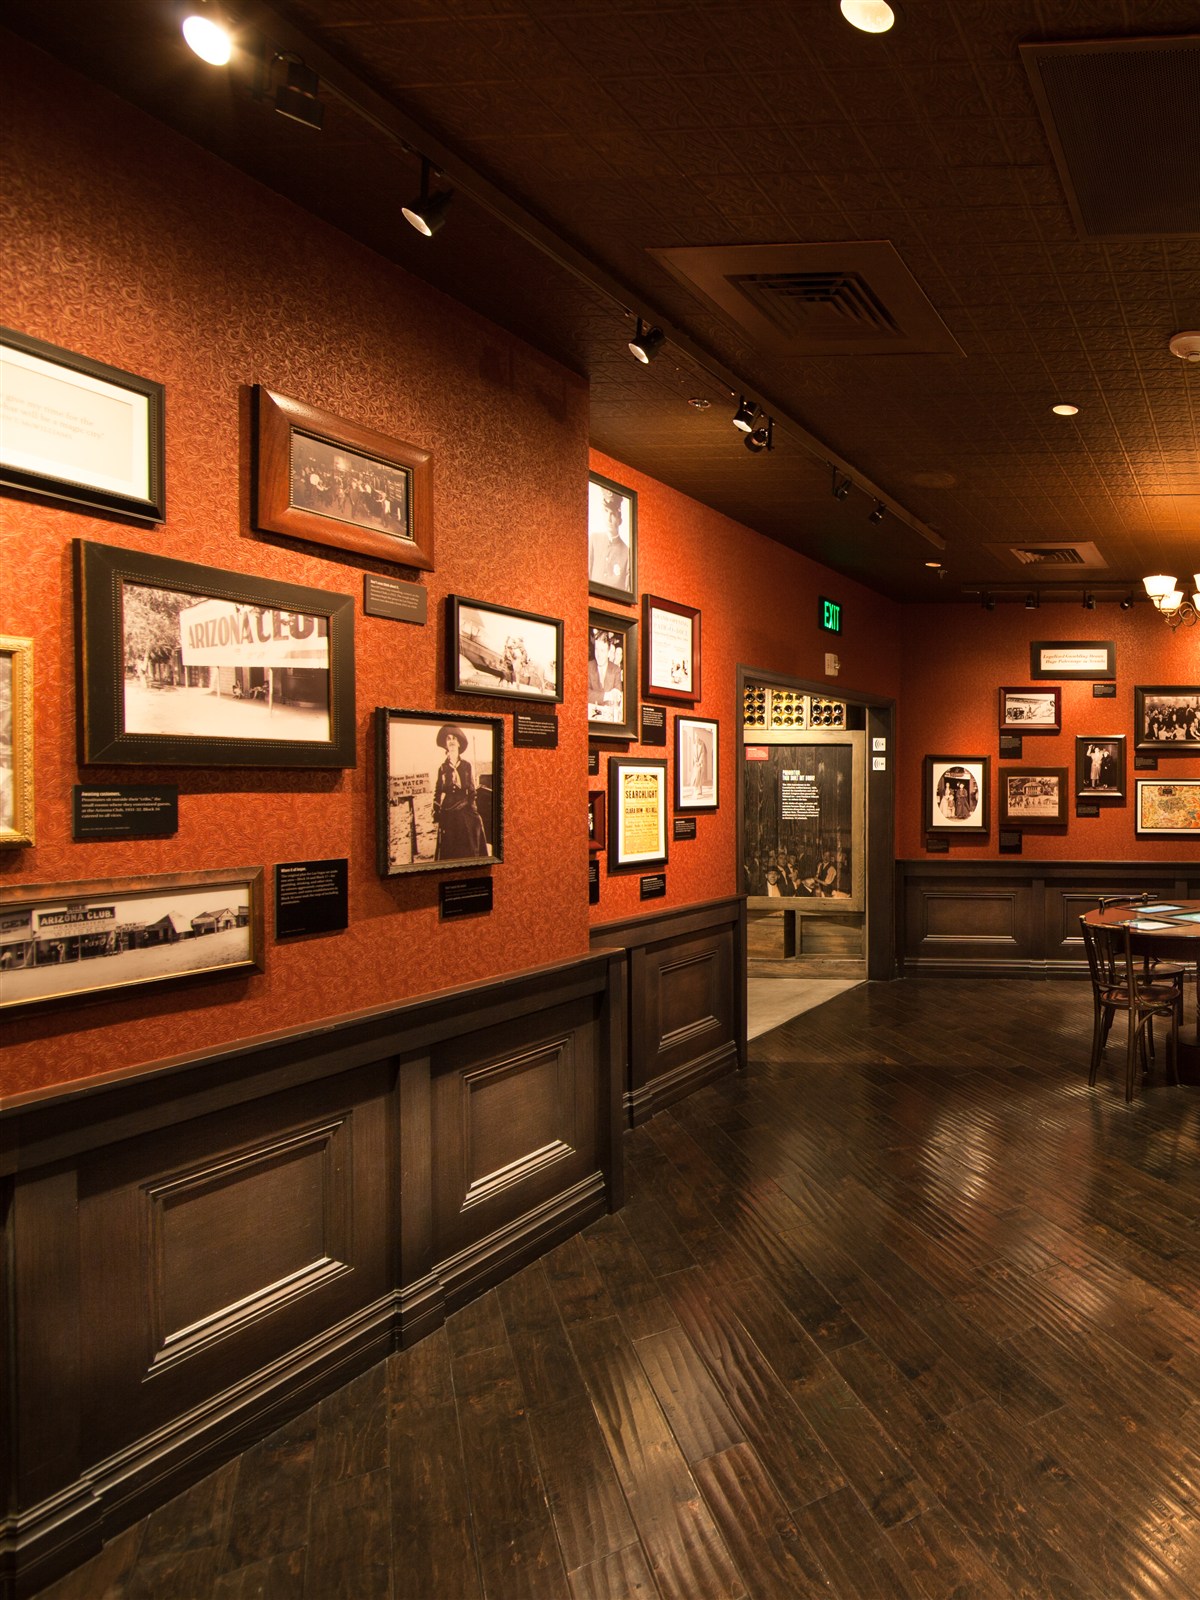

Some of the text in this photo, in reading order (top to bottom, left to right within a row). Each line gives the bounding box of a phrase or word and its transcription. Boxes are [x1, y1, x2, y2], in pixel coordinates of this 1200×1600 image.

[824, 601, 840, 631] EXIT
[189, 611, 254, 649] ARIZONA
[625, 790, 657, 799] SEARCHLIGHT
[40, 910, 114, 926] ARIZONA CLUB.
[54, 927, 107, 937] WHISKEY
